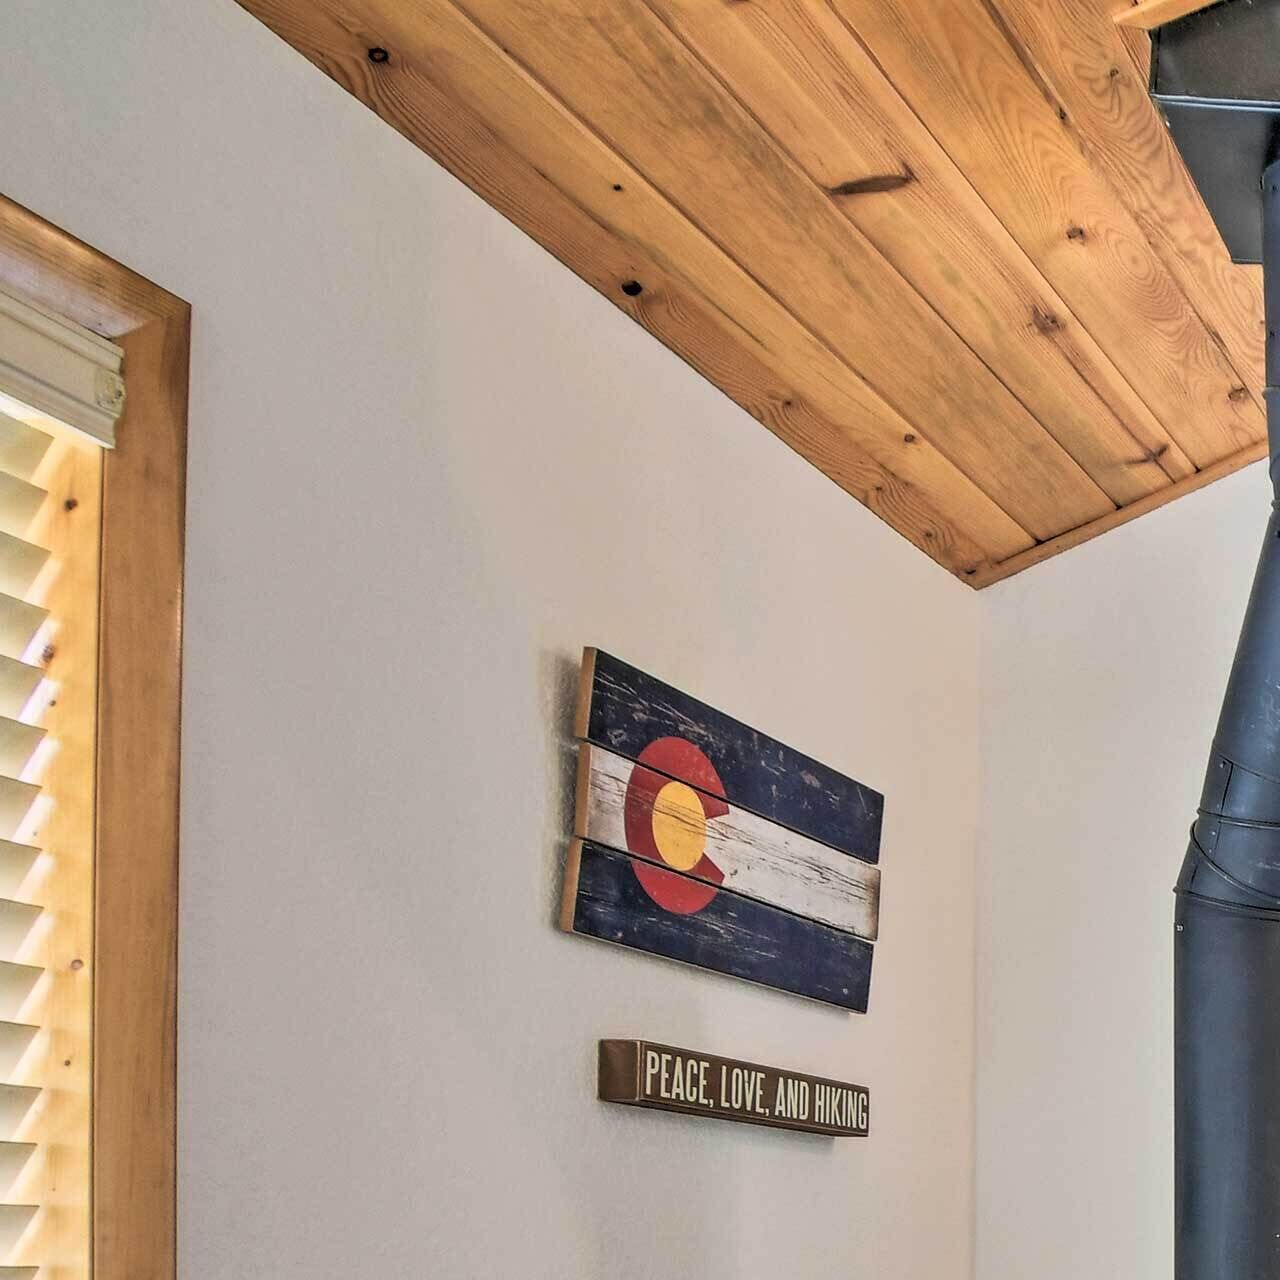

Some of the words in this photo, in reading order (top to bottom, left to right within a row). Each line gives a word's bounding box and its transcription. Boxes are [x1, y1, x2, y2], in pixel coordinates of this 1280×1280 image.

[645, 1050, 714, 1108] PEACE,
[721, 1065, 770, 1117] LOVE,
[774, 1077, 810, 1121] AND
[814, 1083, 868, 1130] HIKING
